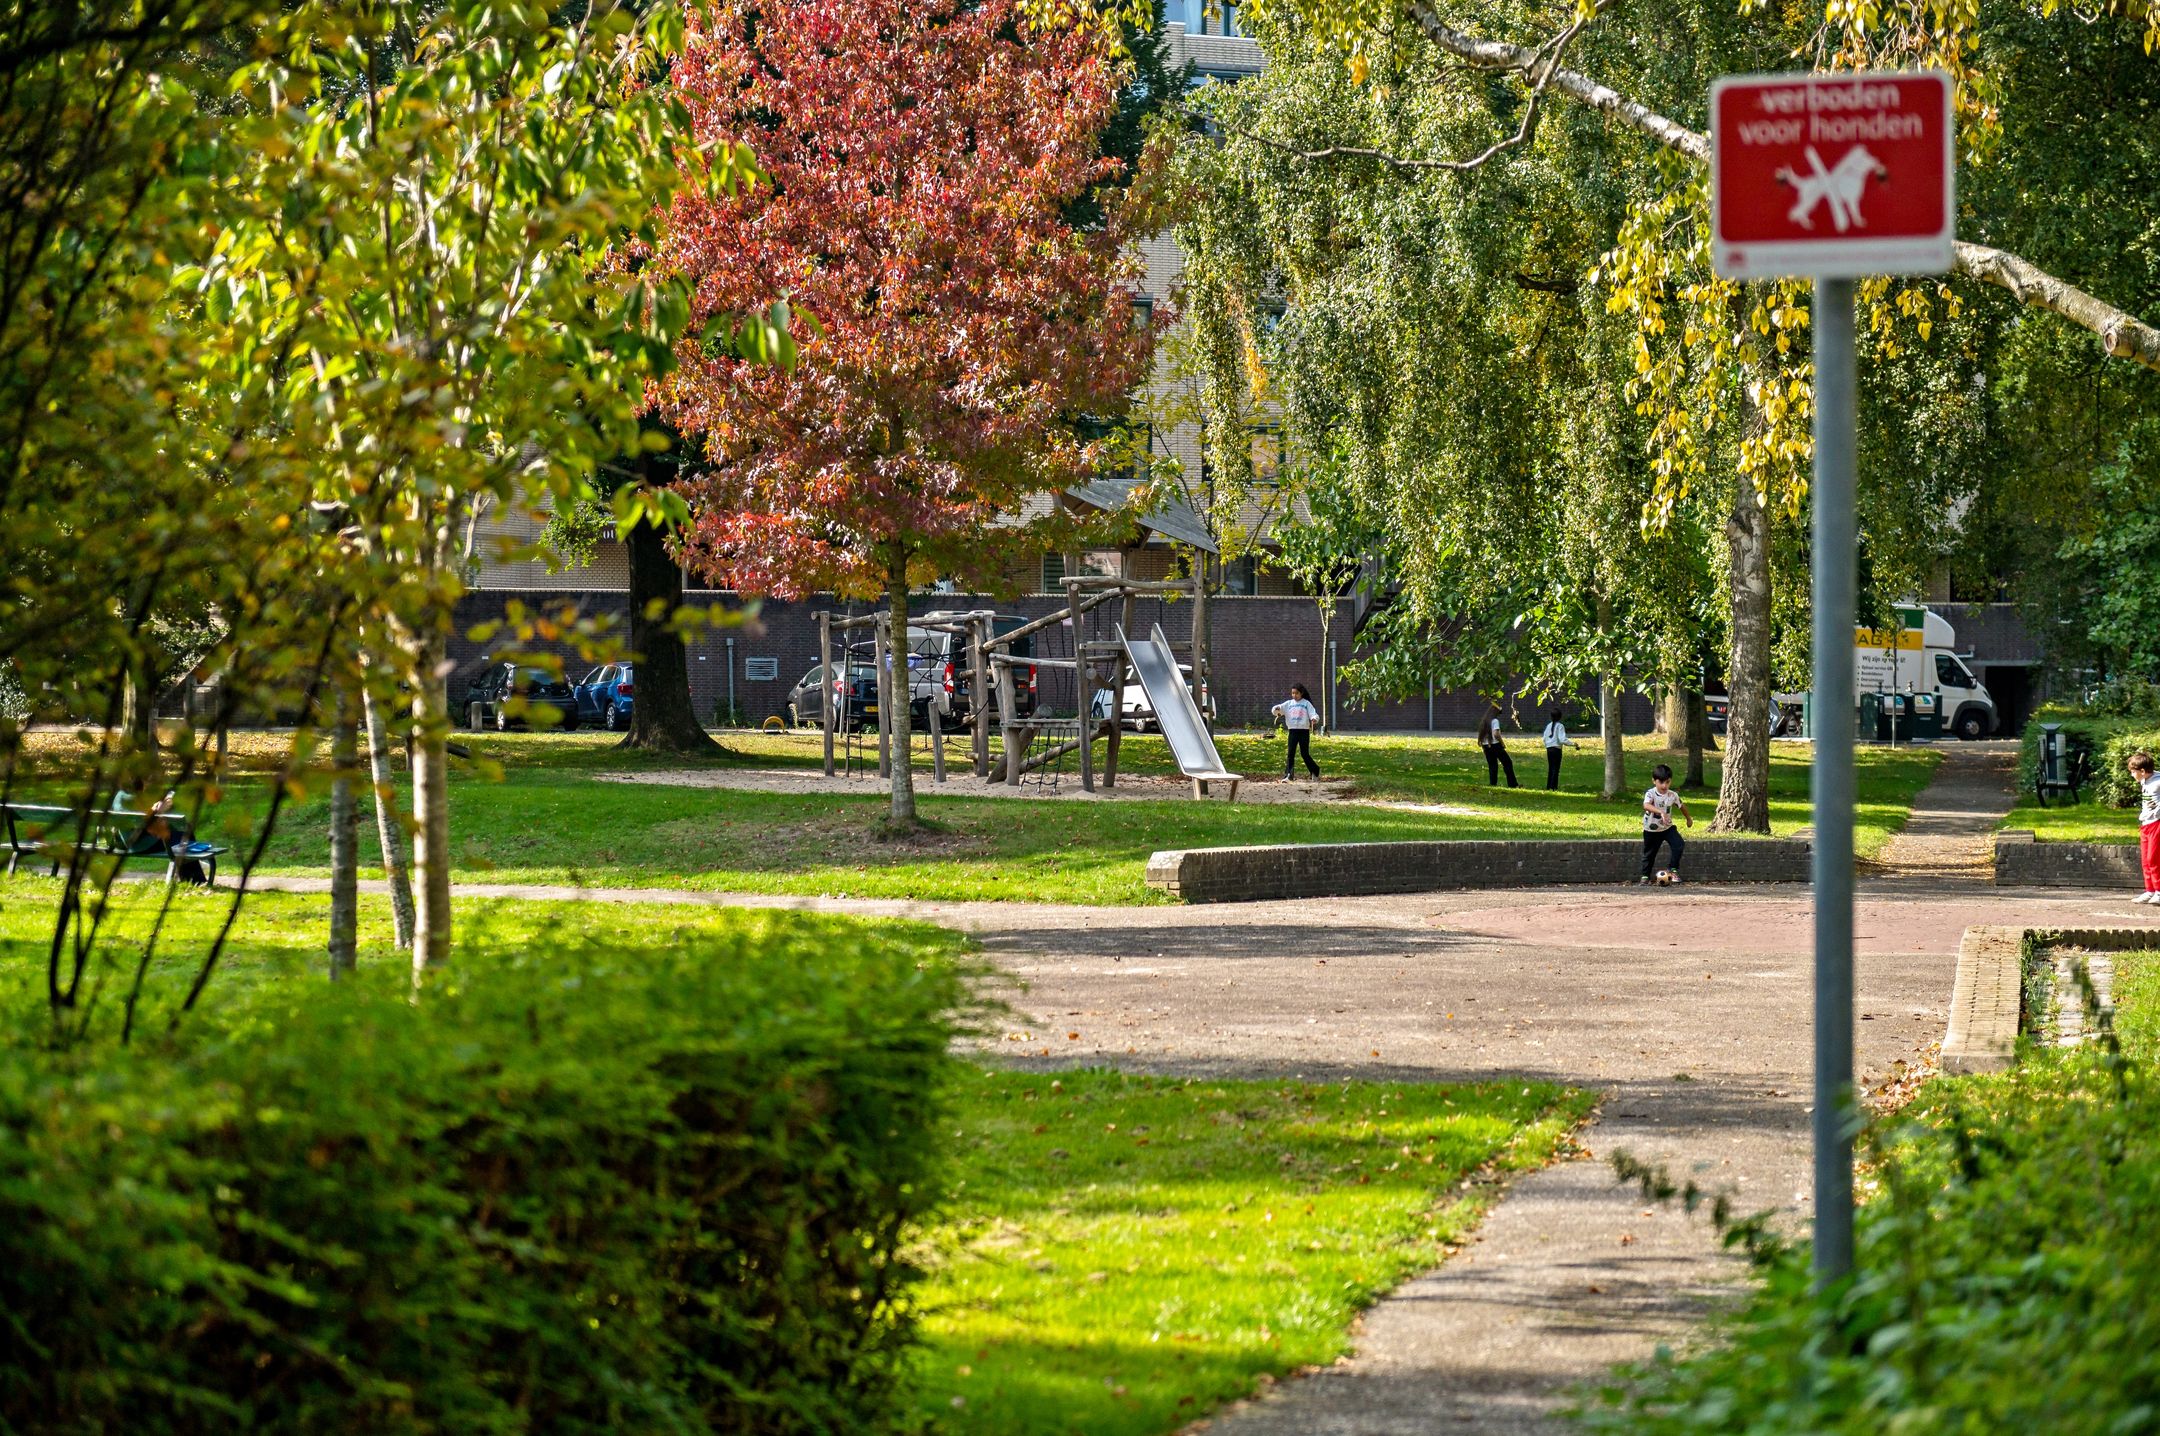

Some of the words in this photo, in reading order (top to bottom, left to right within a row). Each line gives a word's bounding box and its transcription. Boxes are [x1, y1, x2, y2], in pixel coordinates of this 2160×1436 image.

[1760, 82, 1901, 113] verboden
[1738, 118, 1804, 145] voor
[1810, 110, 1924, 143] honden
[1855, 633, 1882, 646] AG
